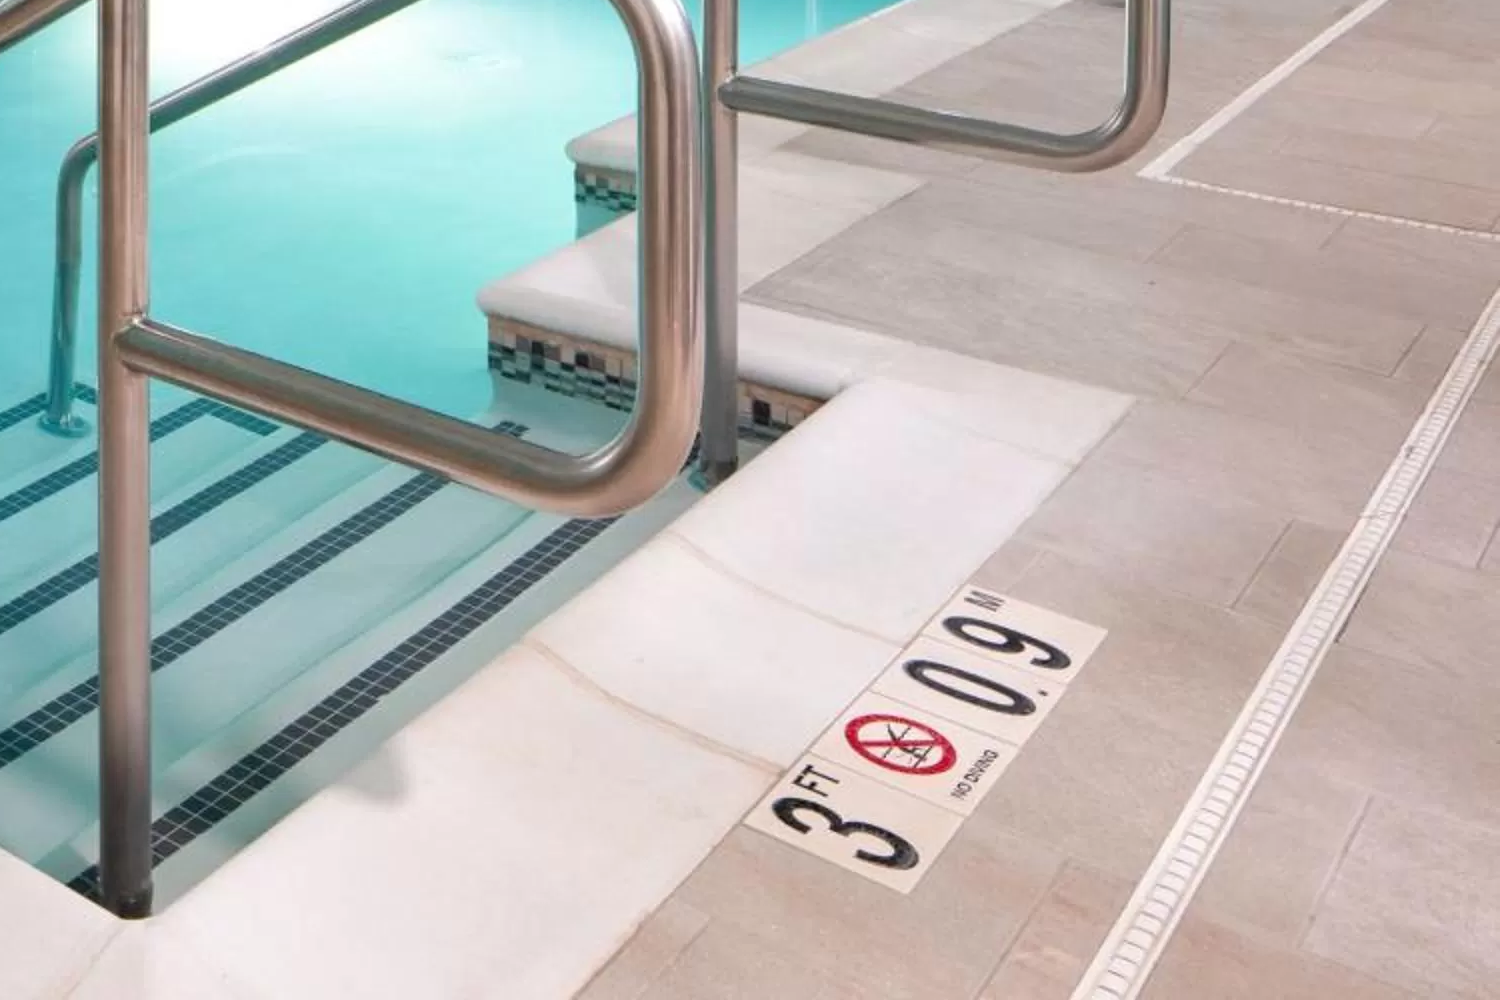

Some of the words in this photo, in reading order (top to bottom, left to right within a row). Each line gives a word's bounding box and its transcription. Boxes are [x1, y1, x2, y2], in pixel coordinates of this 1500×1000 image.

[963, 590, 1006, 613] M
[791, 763, 841, 797] FT
[950, 781, 973, 800] NO
[963, 748, 1000, 784] DIVING
[772, 796, 920, 870] 3
